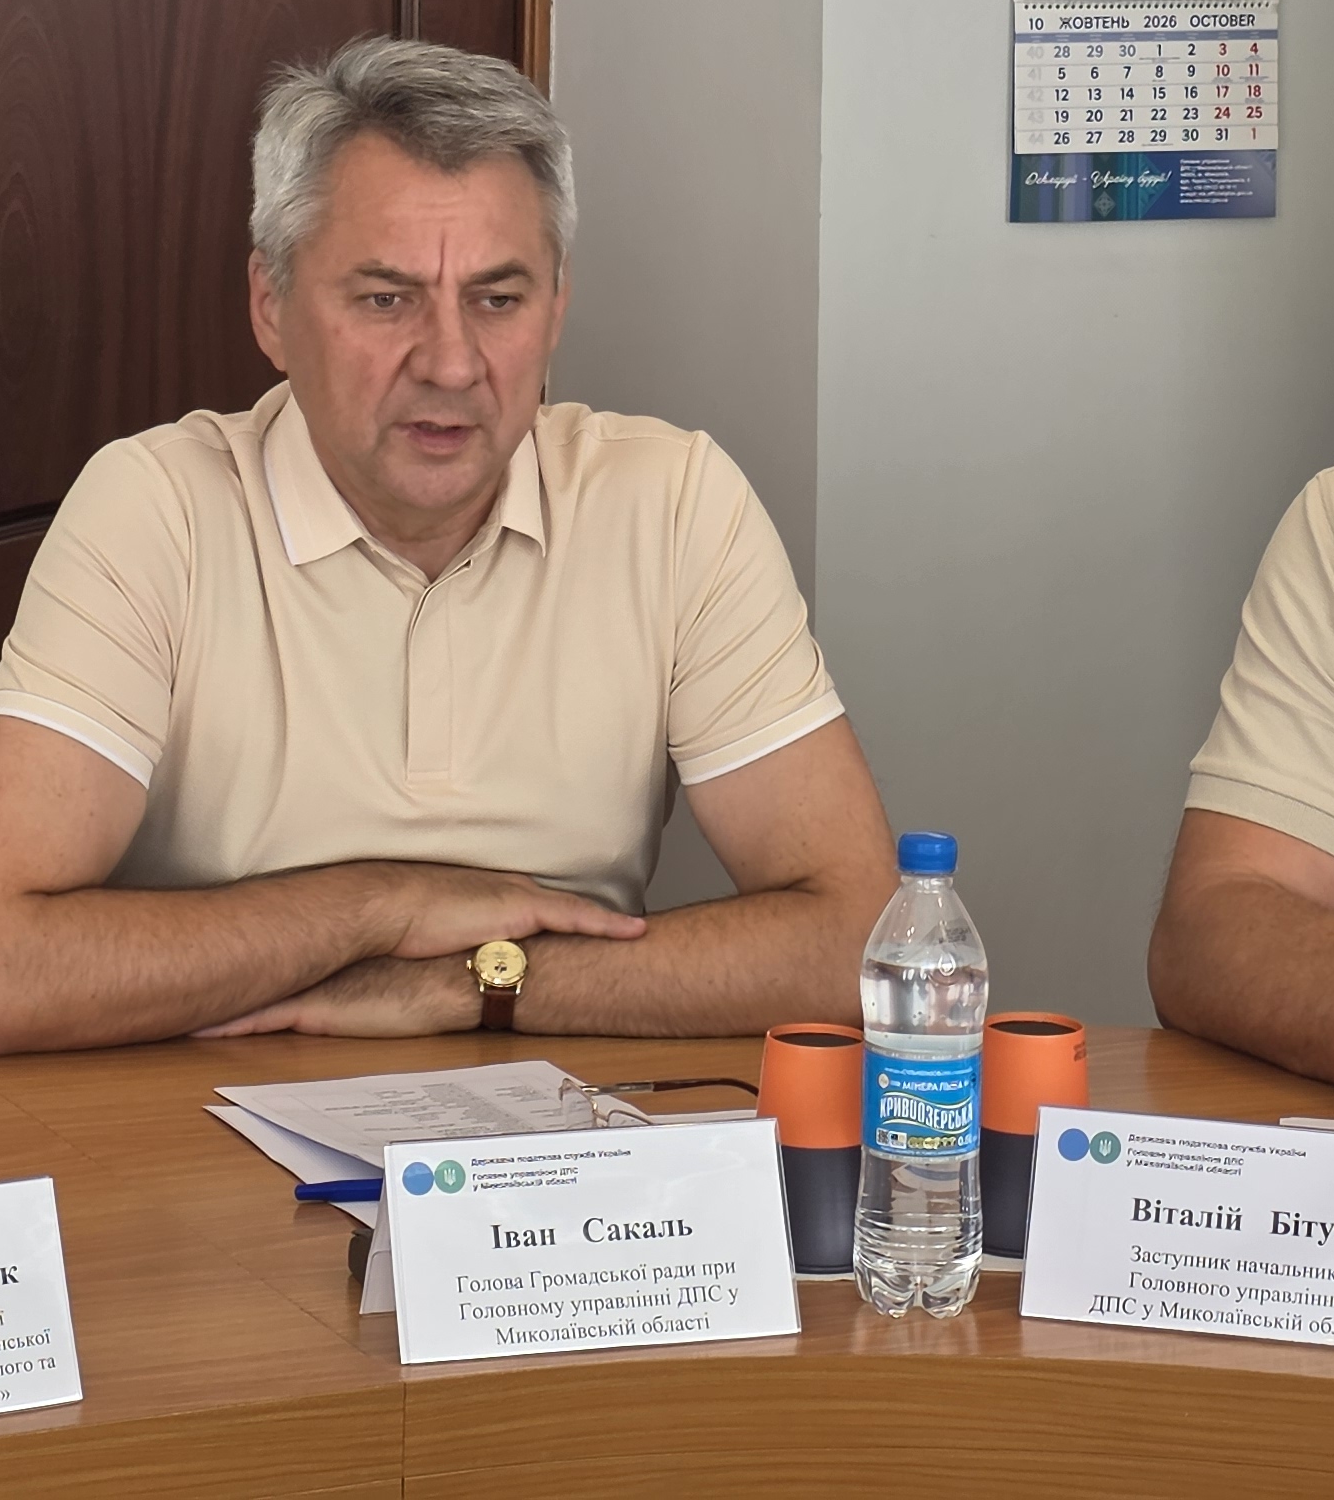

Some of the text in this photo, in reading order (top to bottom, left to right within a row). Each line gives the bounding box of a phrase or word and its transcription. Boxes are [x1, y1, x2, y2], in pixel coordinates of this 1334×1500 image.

[1029, 14, 1255, 30] 10 ЖОВТЕНЬ 2026 OCTOBER
[1054, 43, 1258, 58] 28 29 30 1 2 3 4
[1058, 63, 1259, 79] 5 6 7 8 9 10 11
[1055, 85, 1261, 101] 12 13 14 15 16 17 18
[1055, 106, 1262, 123] 19 20 21 22 23 24 25
[1054, 128, 1256, 144] 26 27 28 29 30 31 1
[880, 1097, 972, 1129] КРИВООЗЕРСЬКА
[1130, 1198, 1242, 1231] Віталій
[492, 1215, 693, 1249] Іван Сакаль
[1130, 1246, 1230, 1273] Заступник
[457, 1260, 735, 1293] Голова Громадської ради при
[1129, 1271, 1229, 1298] Головного
[459, 1286, 738, 1322] Головному управлінні ДПС у
[1089, 1295, 1136, 1315] ДПС
[1143, 1303, 1153, 1320] у
[1160, 1303, 1302, 1332] Миколаївській
[496, 1313, 709, 1346] Миколаївській області
[38, 1357, 55, 1370] та
